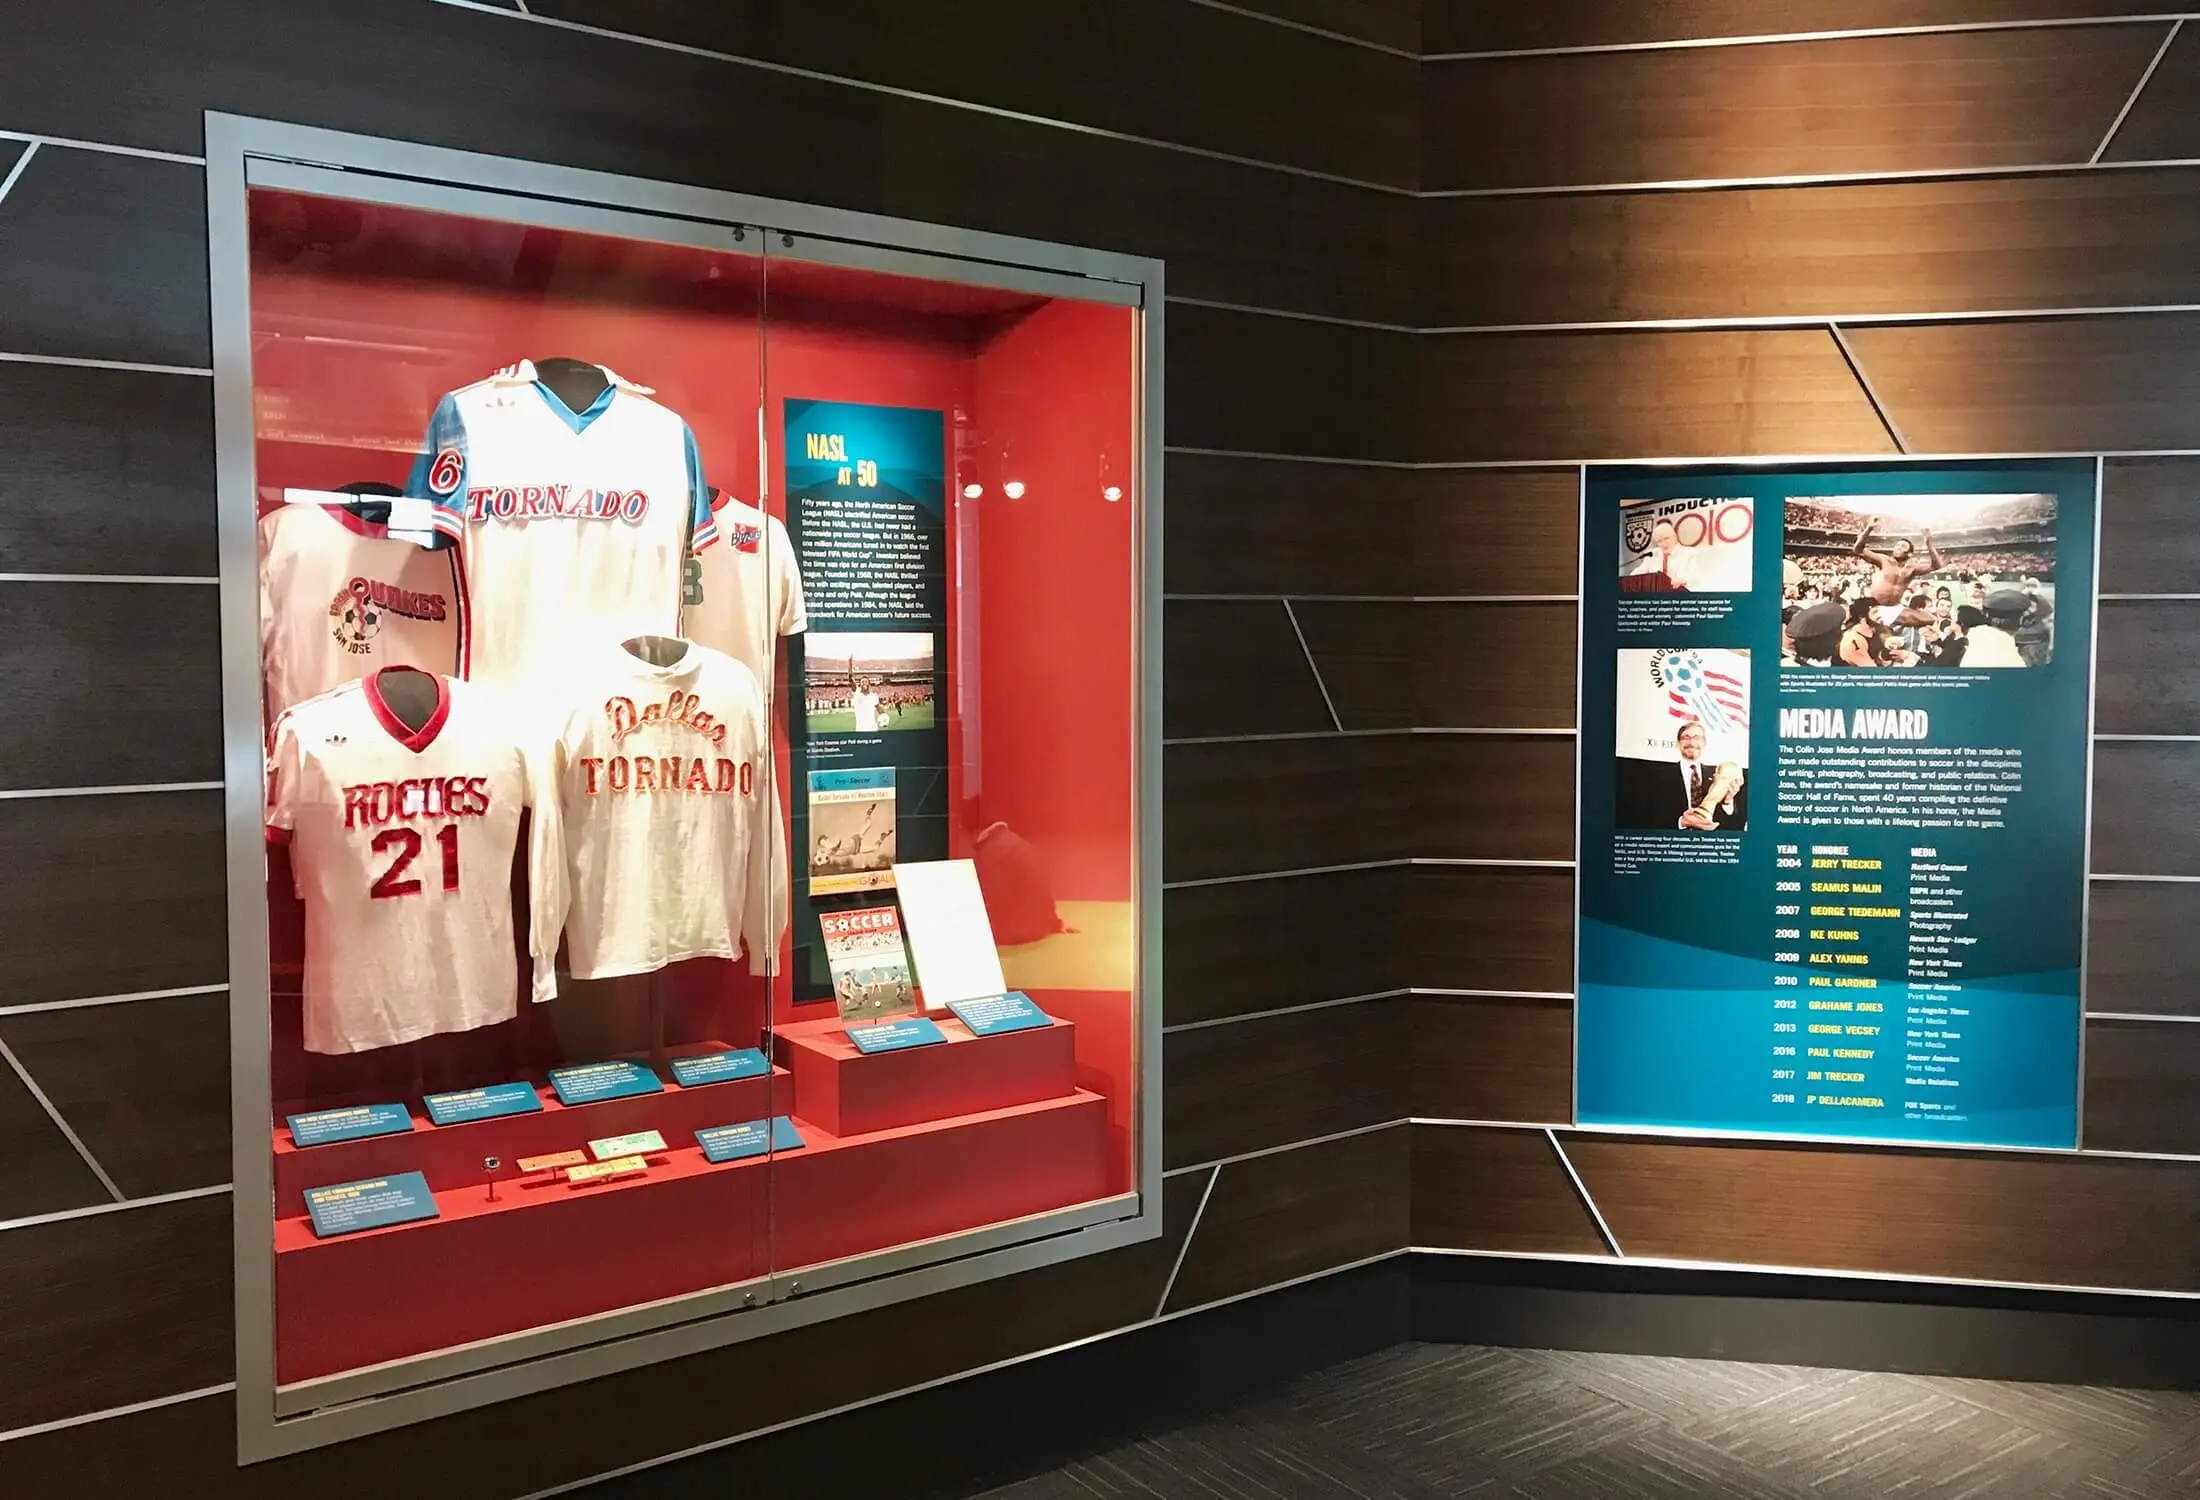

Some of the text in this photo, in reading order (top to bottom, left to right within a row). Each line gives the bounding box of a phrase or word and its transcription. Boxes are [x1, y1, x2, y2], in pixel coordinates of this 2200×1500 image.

[807, 432, 848, 462] NASL
[430, 448, 463, 494] 6
[837, 460, 877, 488] AT 50
[468, 484, 649, 522] TORNADO
[333, 627, 372, 654] SAN JOSE
[1650, 648, 1666, 688] WORLD
[605, 689, 726, 744] Dallas
[1780, 708, 1928, 740] MEDIA AWARD
[1795, 745, 1814, 753] Colin
[1861, 746, 1885, 754] Award
[1821, 758, 1865, 766] outstanding
[1867, 758, 1916, 766] contributions
[579, 756, 753, 796] TORNADO
[1788, 769, 1814, 778] writing,
[1818, 770, 1865, 778] photography,
[1868, 770, 1918, 779] broadcasting,
[1938, 771, 1961, 779] public
[1884, 782, 1899, 790] and
[1902, 782, 1926, 790] former
[342, 776, 490, 828] ROGUES
[1778, 792, 1803, 800] Soccer
[1833, 793, 1856, 801] Fame,
[1859, 794, 1880, 802] spent
[1882, 793, 1894, 801] 40
[1918, 795, 1955, 803] compiling
[1778, 804, 1802, 812] history
[1804, 804, 1812, 812] of
[1811, 817, 1831, 825] given
[1892, 818, 1920, 827] lifelong
[1777, 845, 1848, 855] YEAR HONOREE
[1911, 848, 1936, 856] MEDIA
[371, 824, 459, 899] 21
[1776, 858, 1881, 869] 2004 JERRY TRECKER
[1776, 882, 1881, 892] 2005 SEAMUS MALIN
[1776, 905, 1900, 917] 2007 GEORGE TIEDEMANN
[824, 913, 894, 934] SOCCER
[1909, 921, 1951, 930] Photography
[1775, 929, 1858, 940] 2008 IKE KUHNS
[1775, 952, 1868, 964] 2009 ALEX YANNIS
[1774, 976, 1876, 987] 2010 PAUL GARDNER
[1774, 1000, 1883, 1011] 2012 GRAHAME JONES
[1774, 1023, 1879, 1035] 2013 GEORGE VECSEY
[1773, 1046, 1873, 1058] 2016 PAUL KENNEDY
[1773, 1070, 1864, 1081] 2017 JIM TRECKER
[1772, 1094, 1883, 1106] 2018 JP DELLACAMERA
